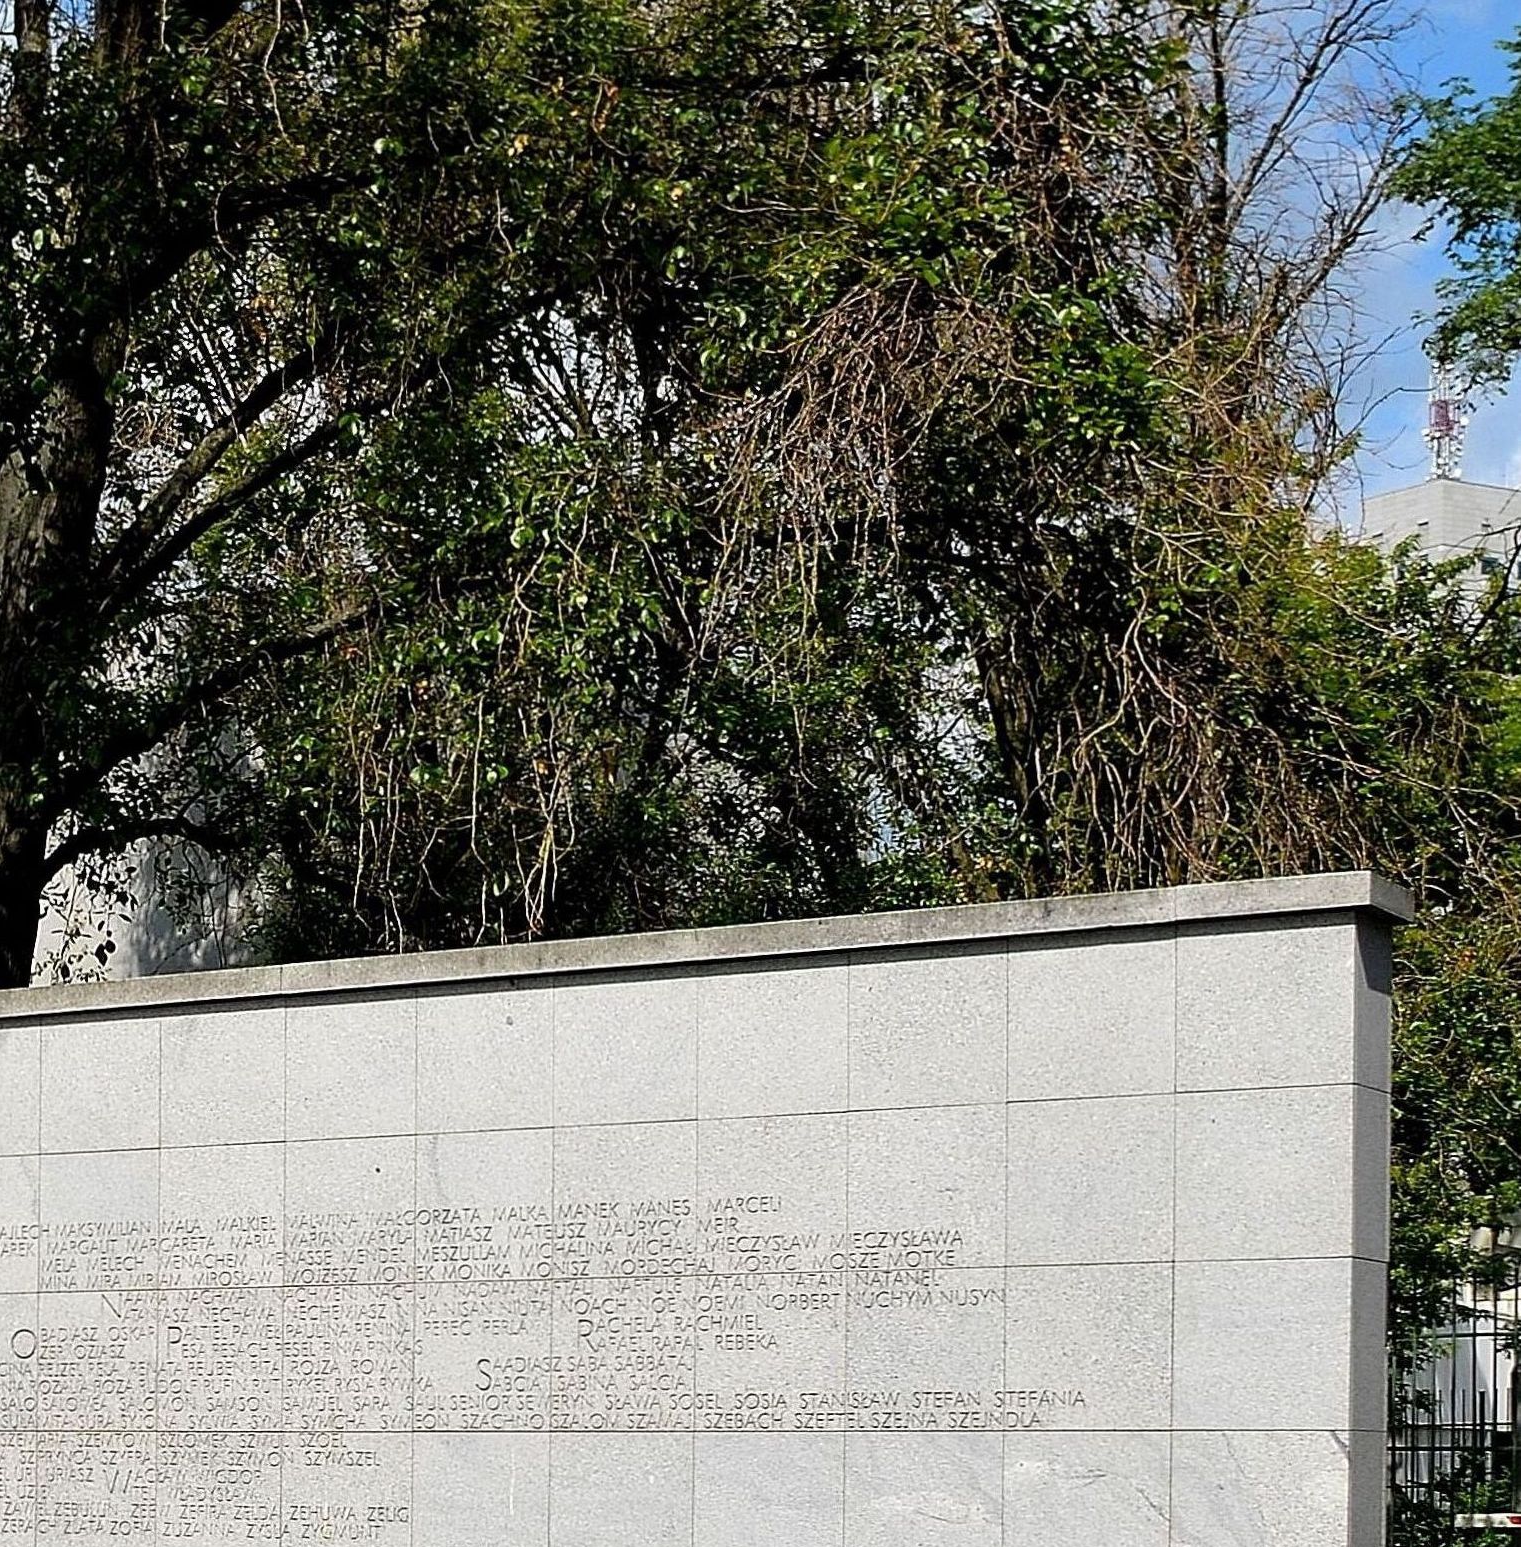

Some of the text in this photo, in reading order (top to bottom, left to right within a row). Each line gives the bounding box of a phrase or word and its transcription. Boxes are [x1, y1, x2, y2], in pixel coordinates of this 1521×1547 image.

[558, 1202, 619, 1219] MANEK
[912, 1390, 981, 1409] STEFAN
[993, 1390, 1087, 1408] STEFANIA
